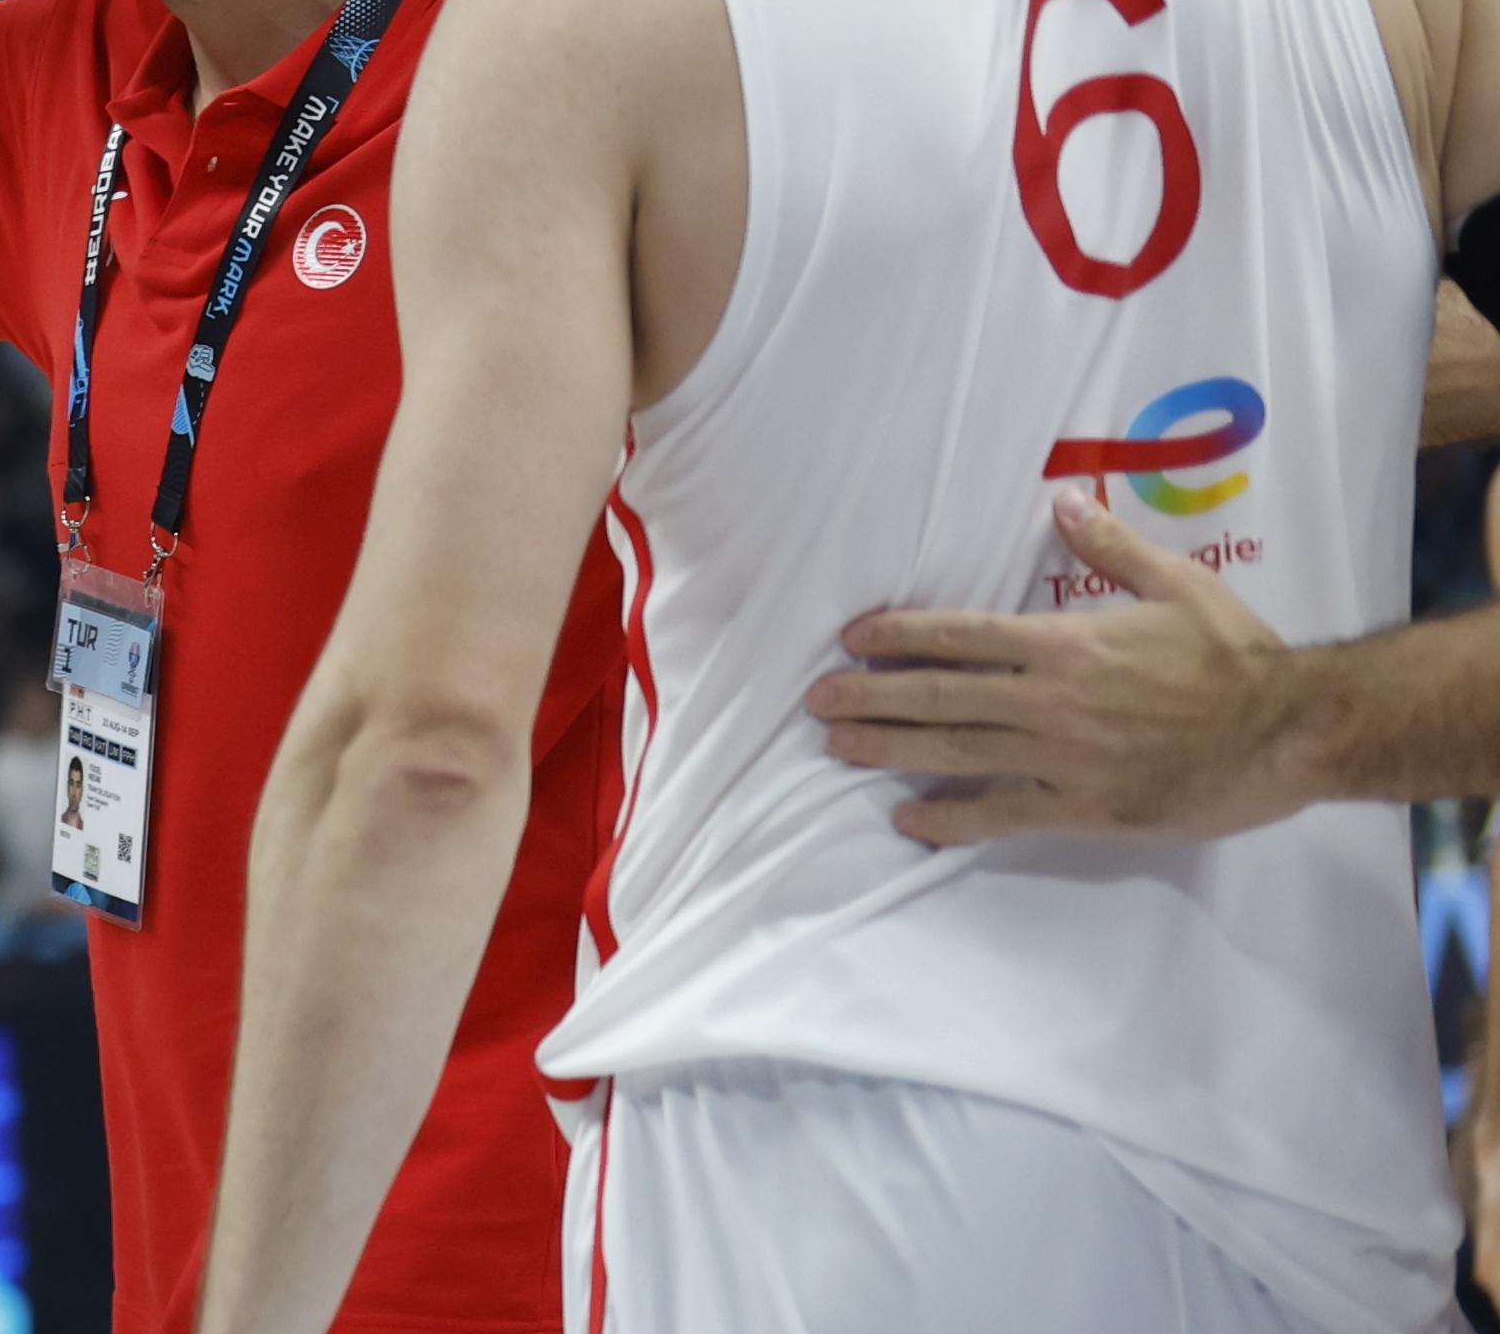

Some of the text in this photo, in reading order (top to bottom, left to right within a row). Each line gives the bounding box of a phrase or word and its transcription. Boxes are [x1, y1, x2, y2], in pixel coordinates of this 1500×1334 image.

[213, 95, 328, 316] MAKE YOUR MARK
[67, 618, 99, 651] TUR
